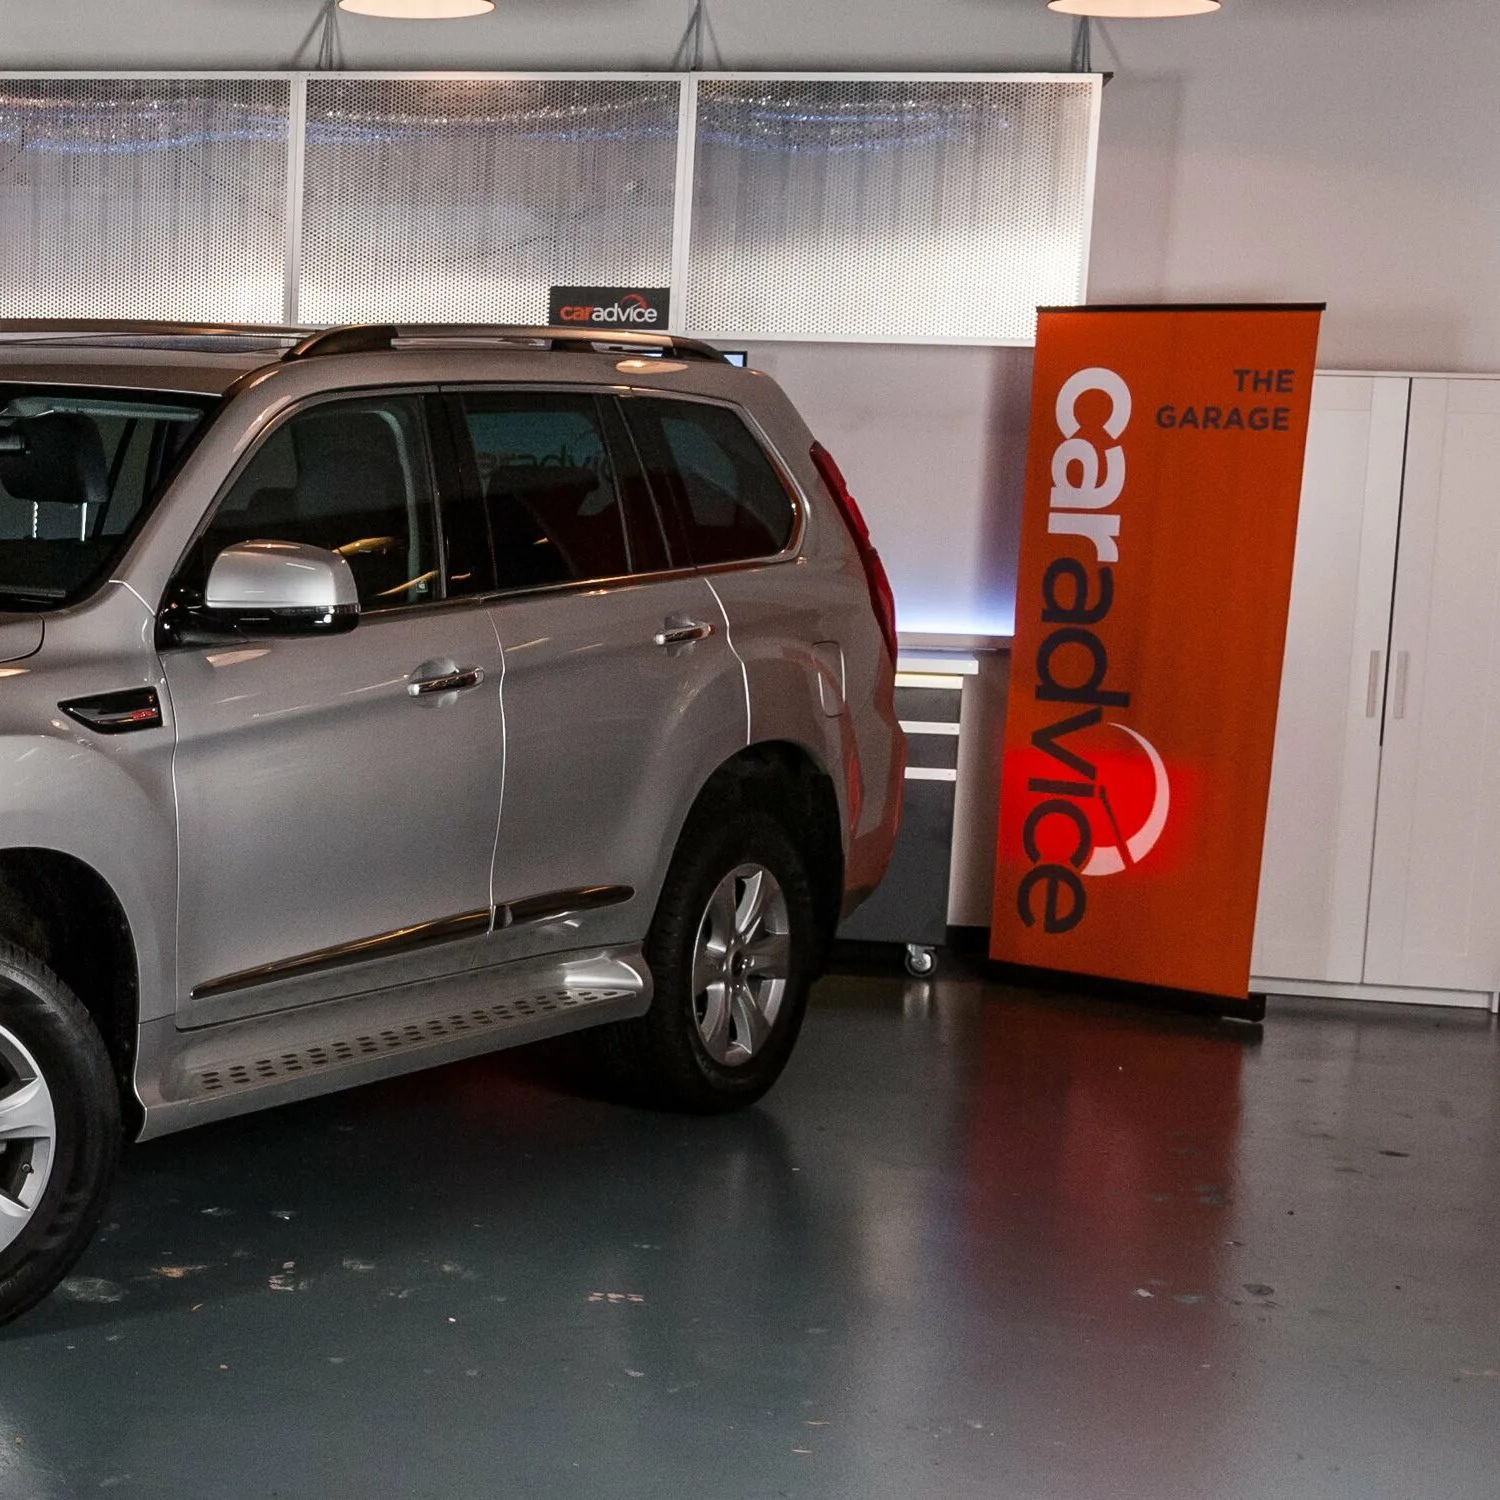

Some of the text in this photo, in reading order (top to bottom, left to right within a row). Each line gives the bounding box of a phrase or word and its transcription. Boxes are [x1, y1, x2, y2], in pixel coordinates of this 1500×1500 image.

[559, 303, 658, 323] caradvice
[1233, 368, 1295, 393] THE
[1155, 404, 1291, 431] GARAGE
[1016, 366, 1132, 934] caradvice
